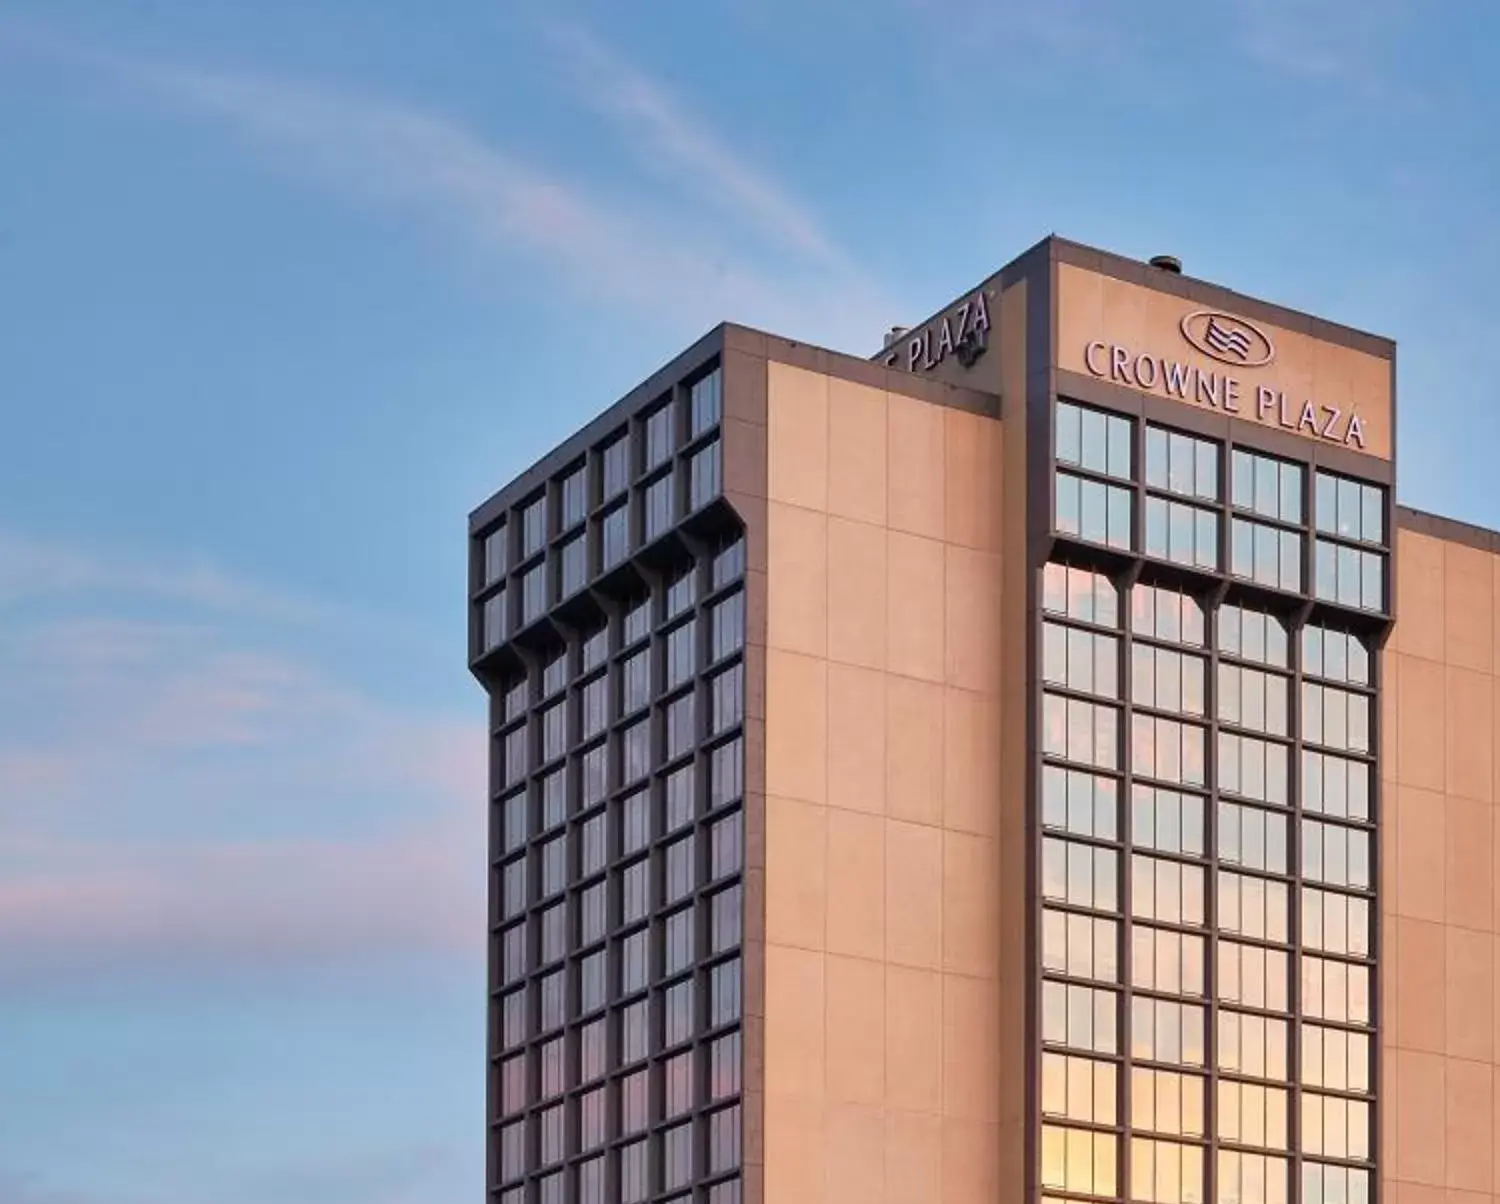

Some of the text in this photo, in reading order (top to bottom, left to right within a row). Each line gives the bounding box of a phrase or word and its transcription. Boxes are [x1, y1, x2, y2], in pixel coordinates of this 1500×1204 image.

[908, 291, 991, 372] PLAZA
[1085, 341, 1366, 449] CROWNE PLAZA
